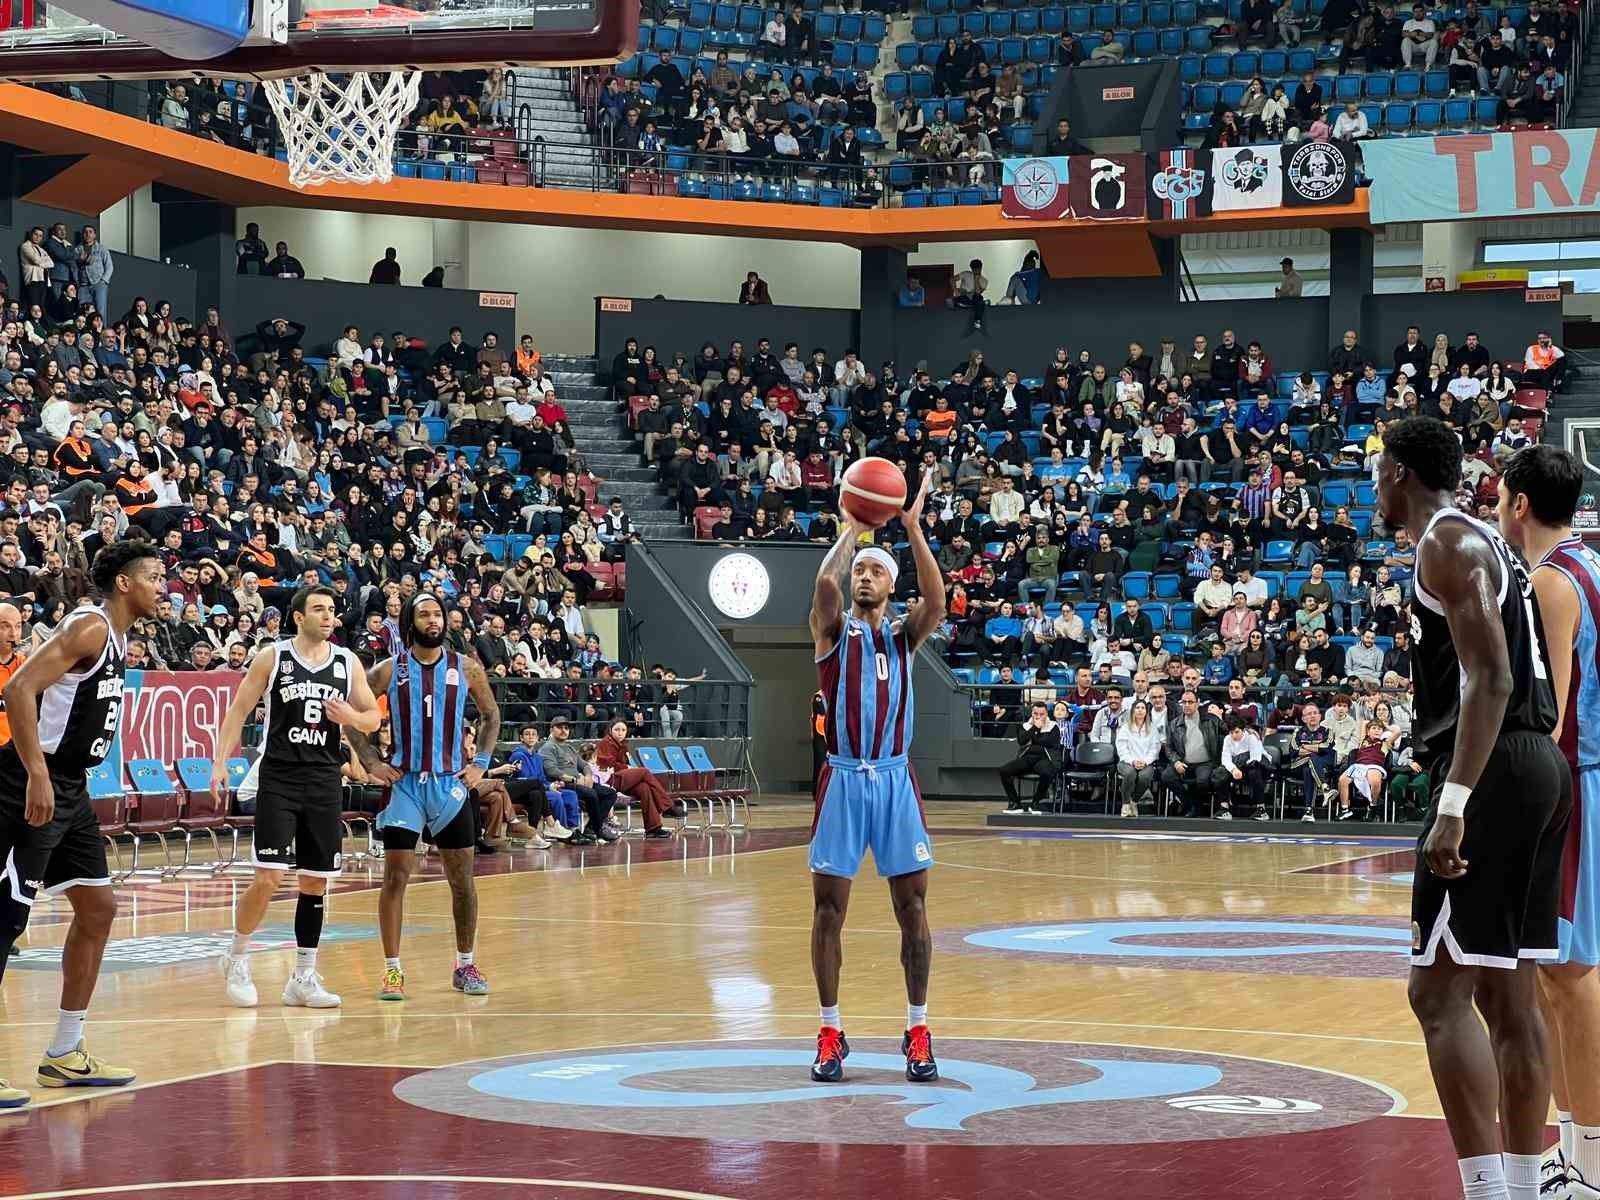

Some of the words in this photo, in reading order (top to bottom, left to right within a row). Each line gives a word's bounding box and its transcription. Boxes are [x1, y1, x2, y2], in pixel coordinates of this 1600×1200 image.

[875, 653, 888, 680] 0
[304, 700, 322, 724] 6
[423, 694, 433, 717] 1
